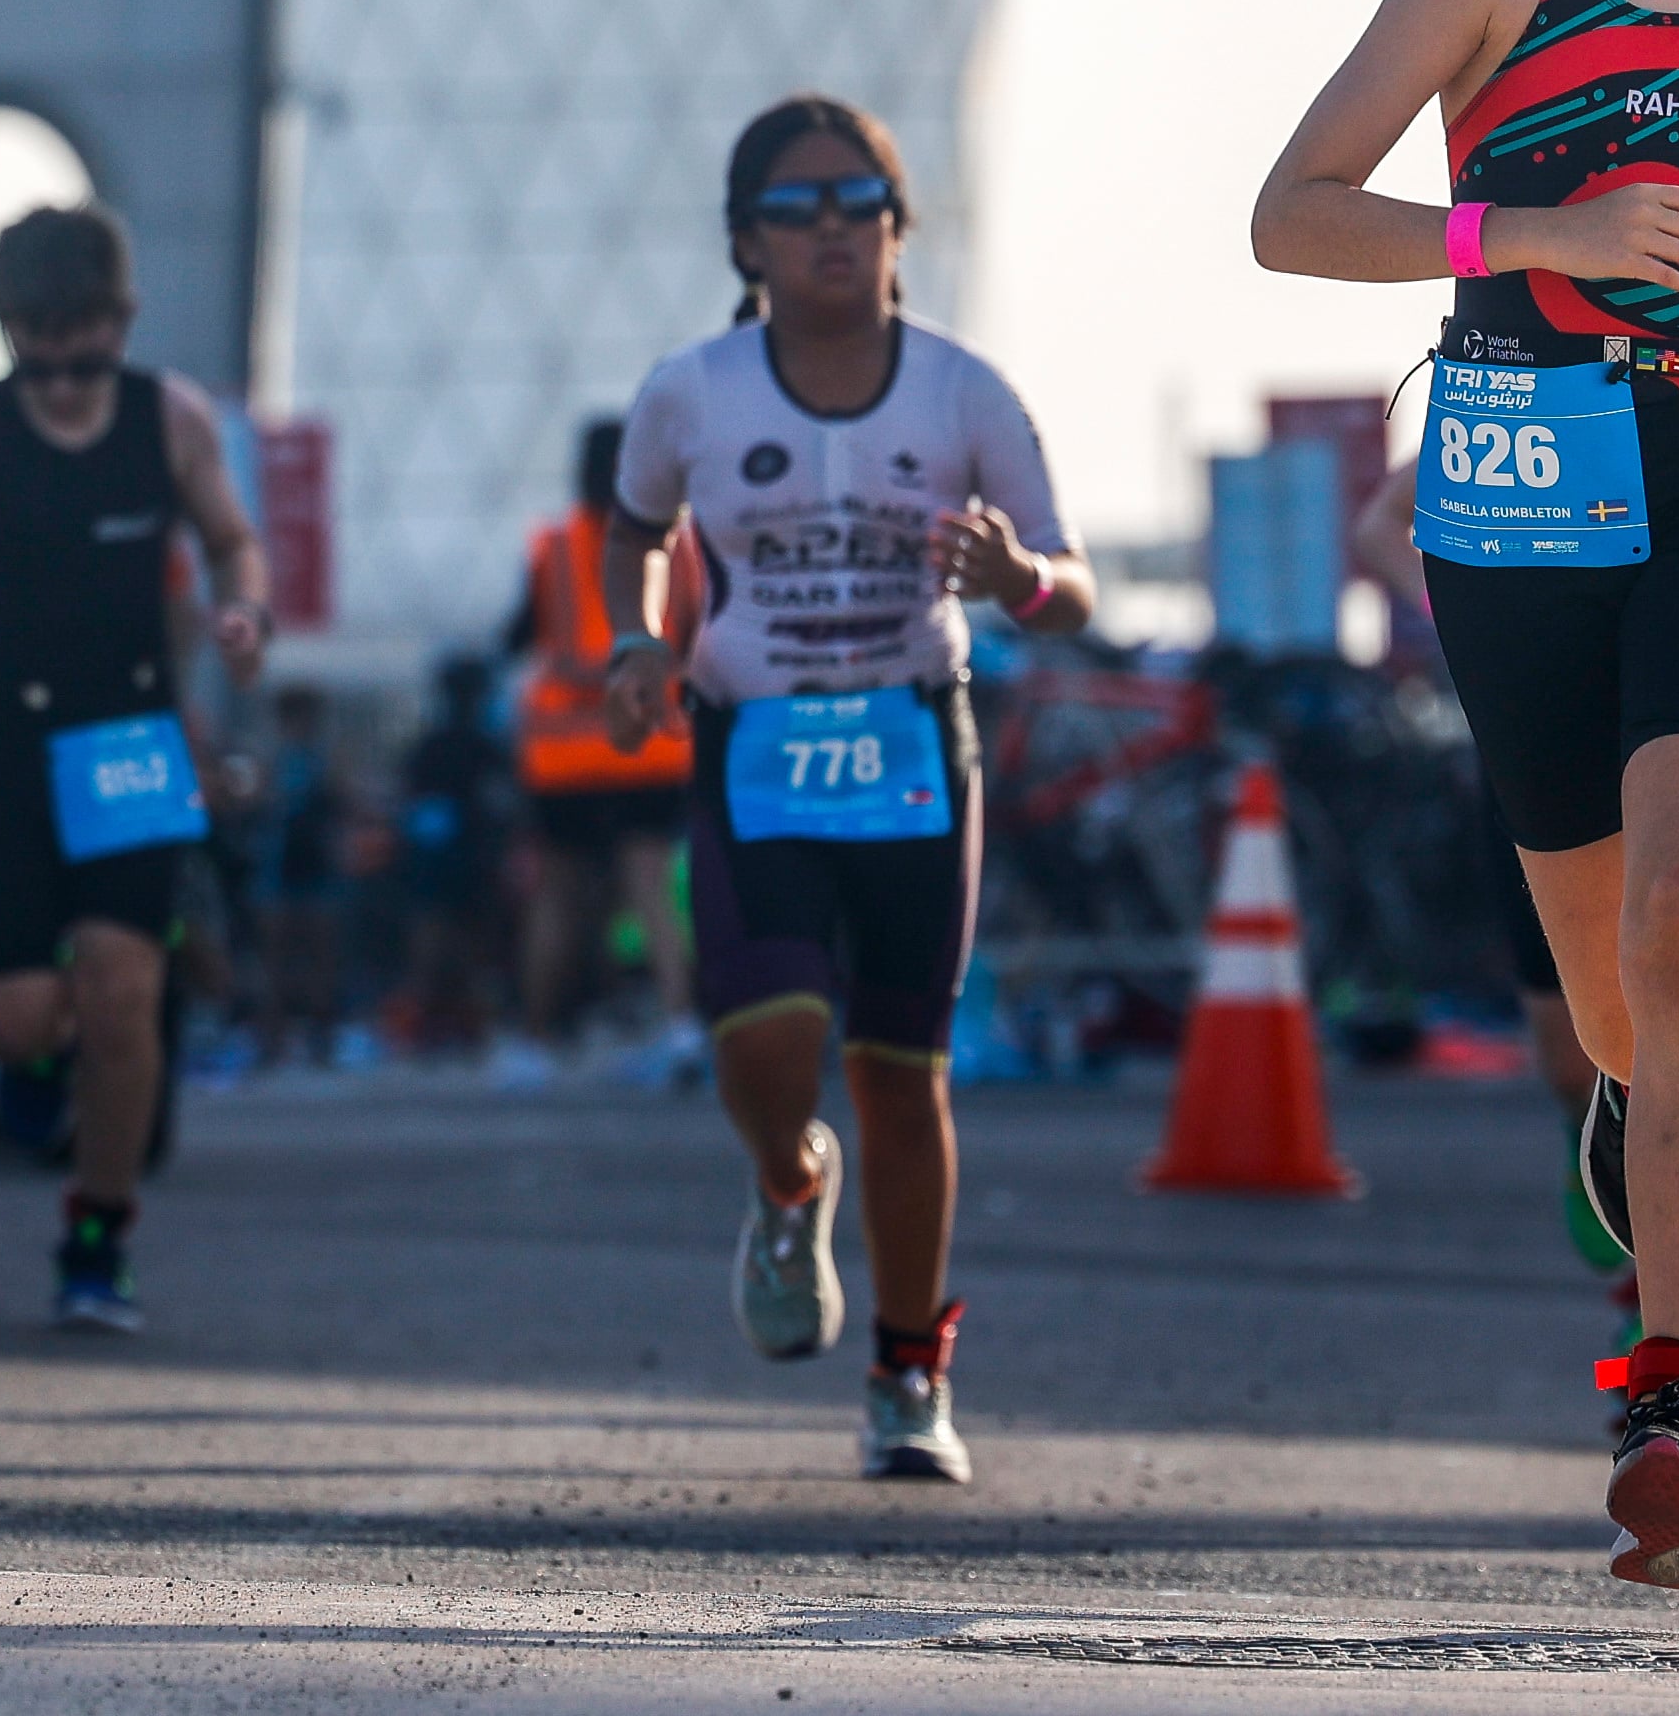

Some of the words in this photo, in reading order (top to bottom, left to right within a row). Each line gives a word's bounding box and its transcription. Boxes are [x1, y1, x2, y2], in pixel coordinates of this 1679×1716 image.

[1487, 334, 1519, 349] World
[1487, 346, 1534, 362] Triathlon
[1442, 365, 1483, 388] TRI
[1486, 370, 1536, 391] YAS
[1444, 389, 1475, 406] ياس
[1476, 391, 1533, 410] ترايثلون
[1440, 416, 1560, 488] 826
[1439, 497, 1489, 518] ISABELLA
[1491, 506, 1572, 519] GUMBLETON
[782, 735, 883, 789] 778
